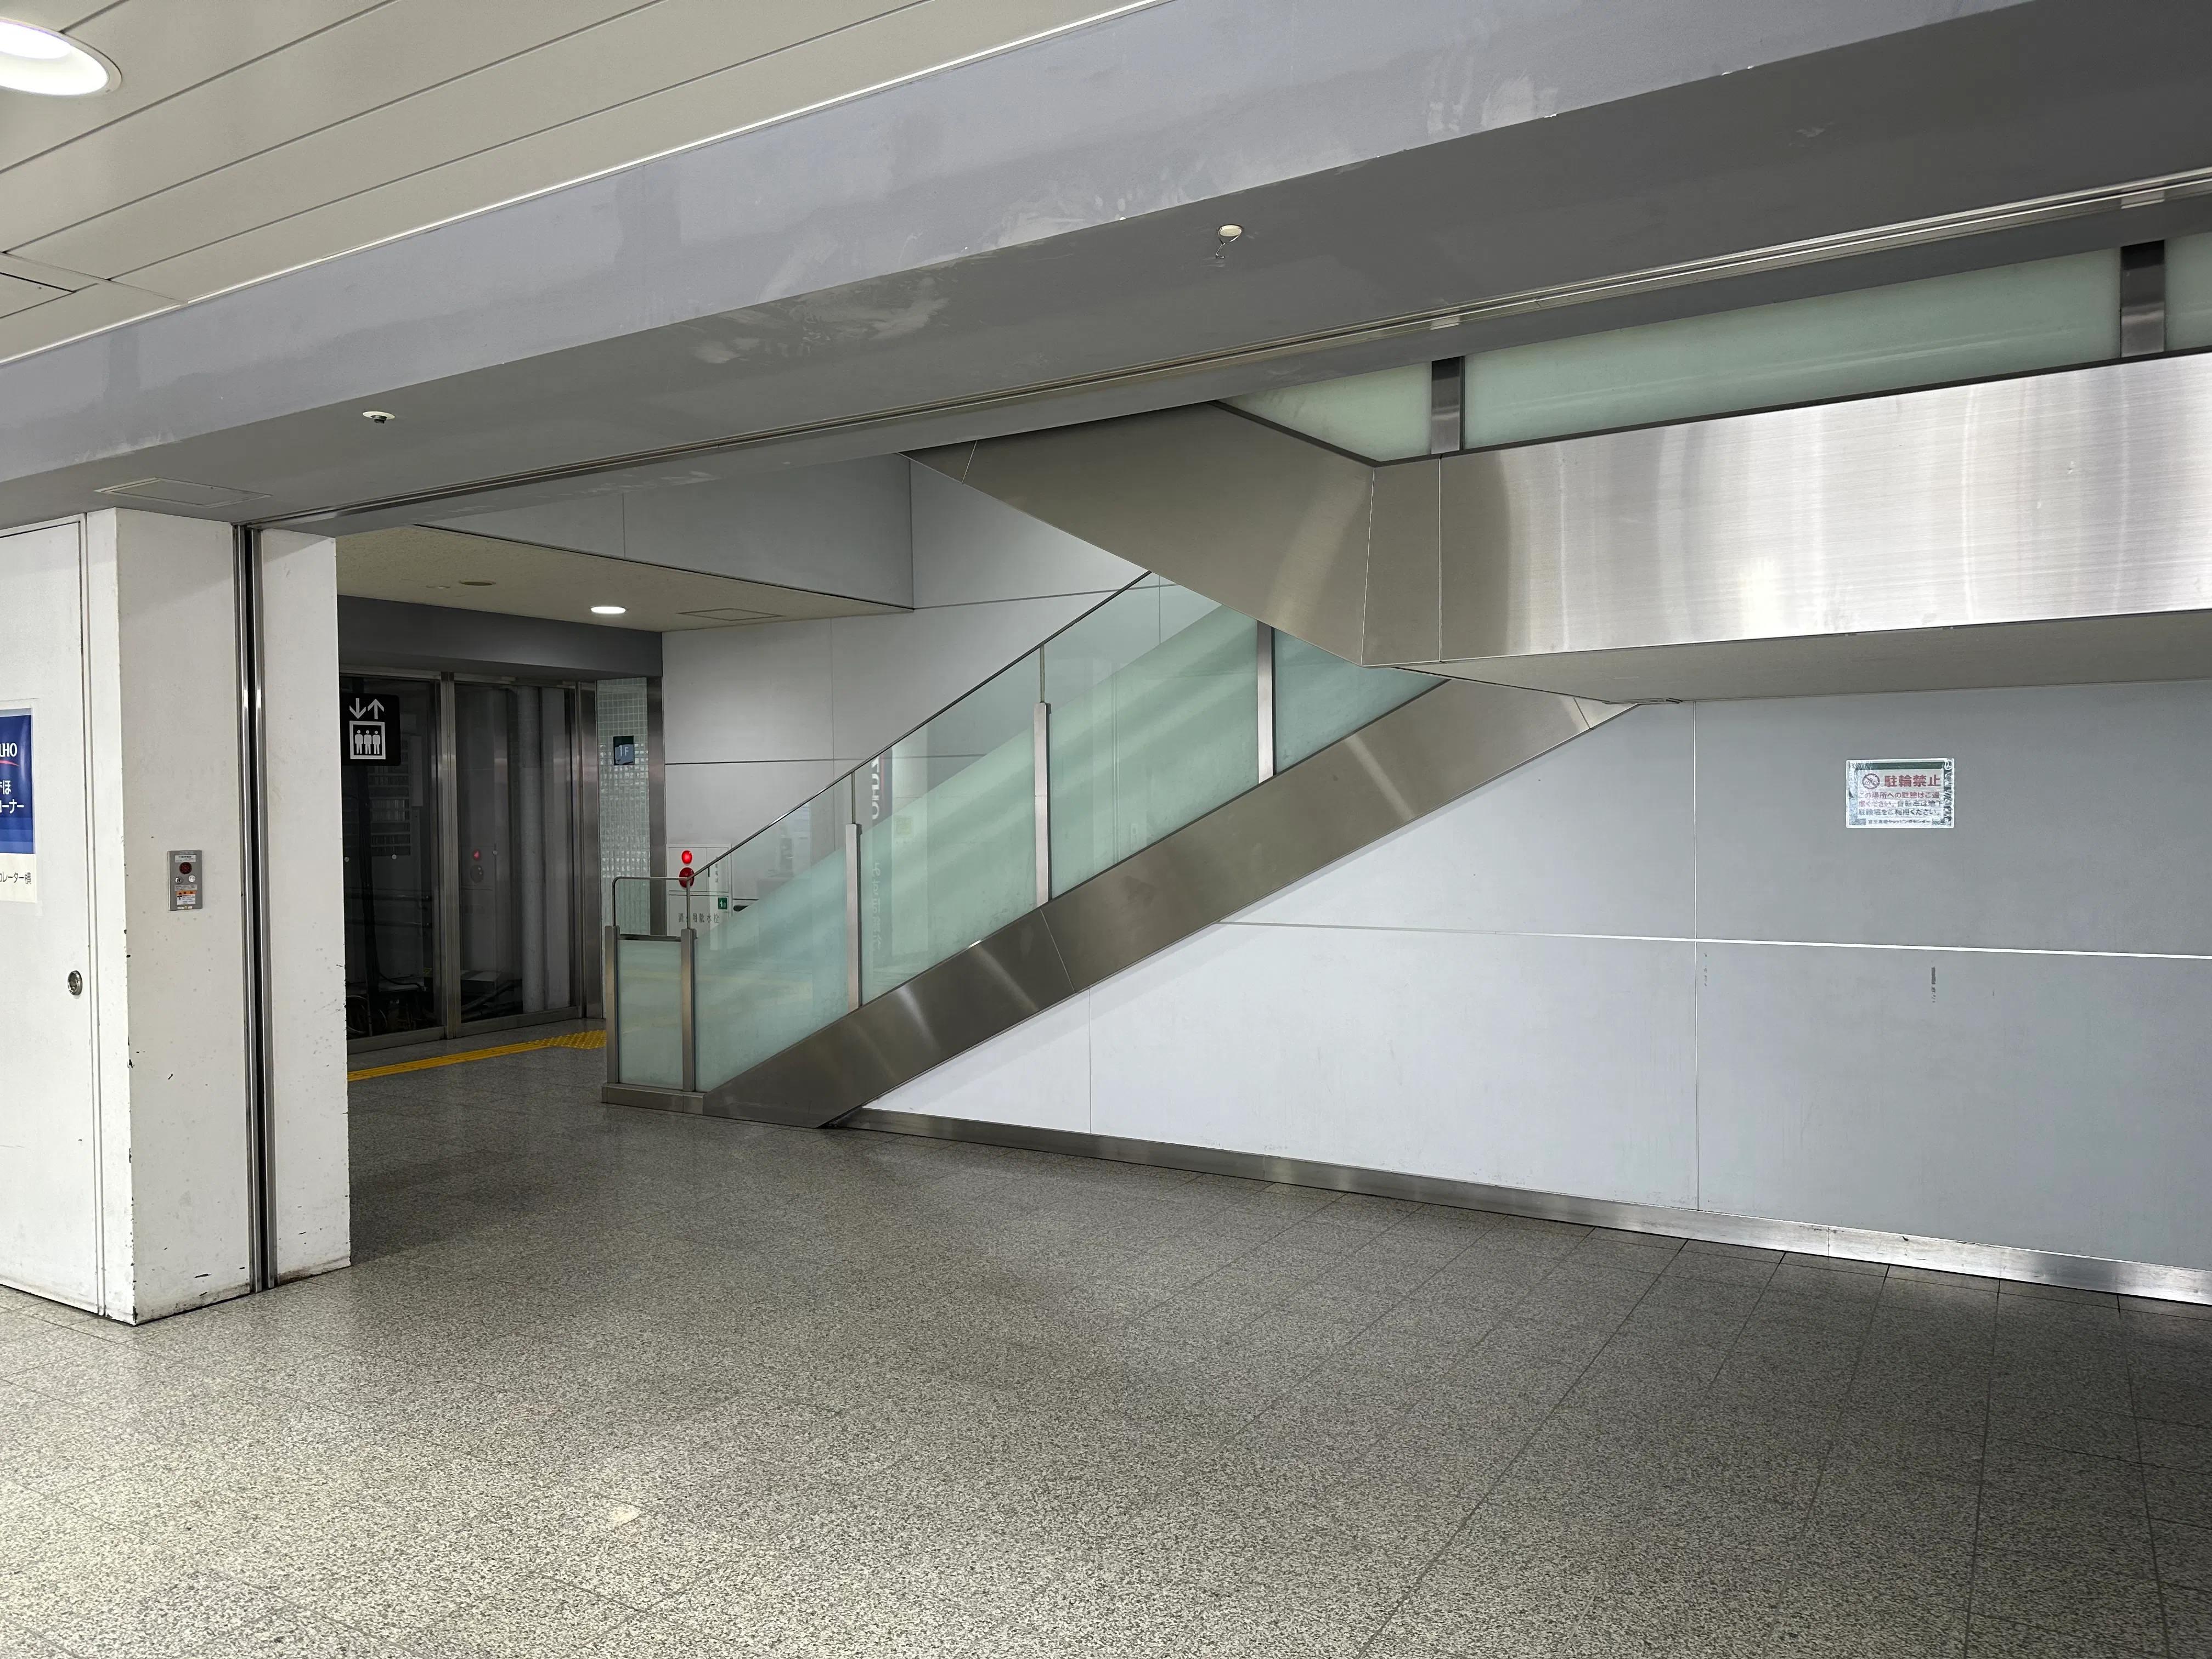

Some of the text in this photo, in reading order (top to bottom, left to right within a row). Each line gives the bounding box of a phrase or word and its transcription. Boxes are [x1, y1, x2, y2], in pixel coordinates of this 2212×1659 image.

[619, 745, 629, 757] 1F
[1884, 775, 1941, 787] 駐輪禁止
[0, 799, 24, 814] ーナー
[678, 912, 719, 923] 消用散水栓
